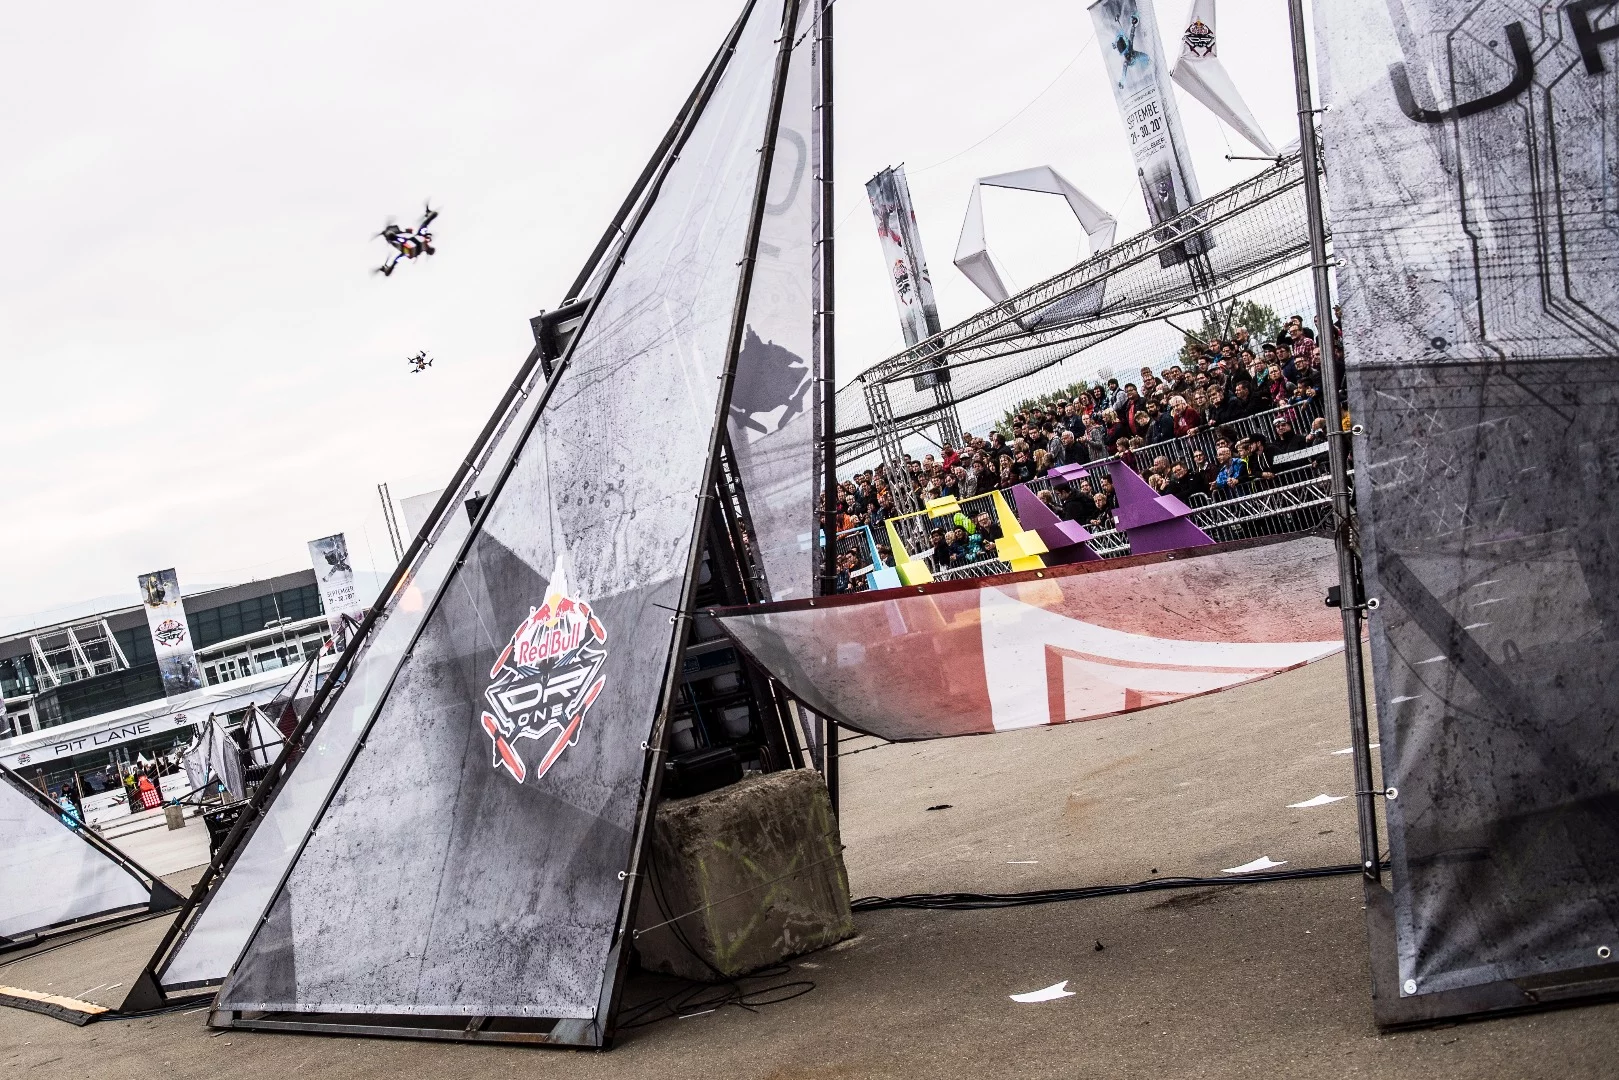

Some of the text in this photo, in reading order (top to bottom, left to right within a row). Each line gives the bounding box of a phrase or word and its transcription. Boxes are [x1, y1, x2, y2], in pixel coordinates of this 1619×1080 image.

[518, 622, 581, 665] Red Bull
[518, 702, 564, 727] ONE
[54, 722, 152, 756] PIT LANE
